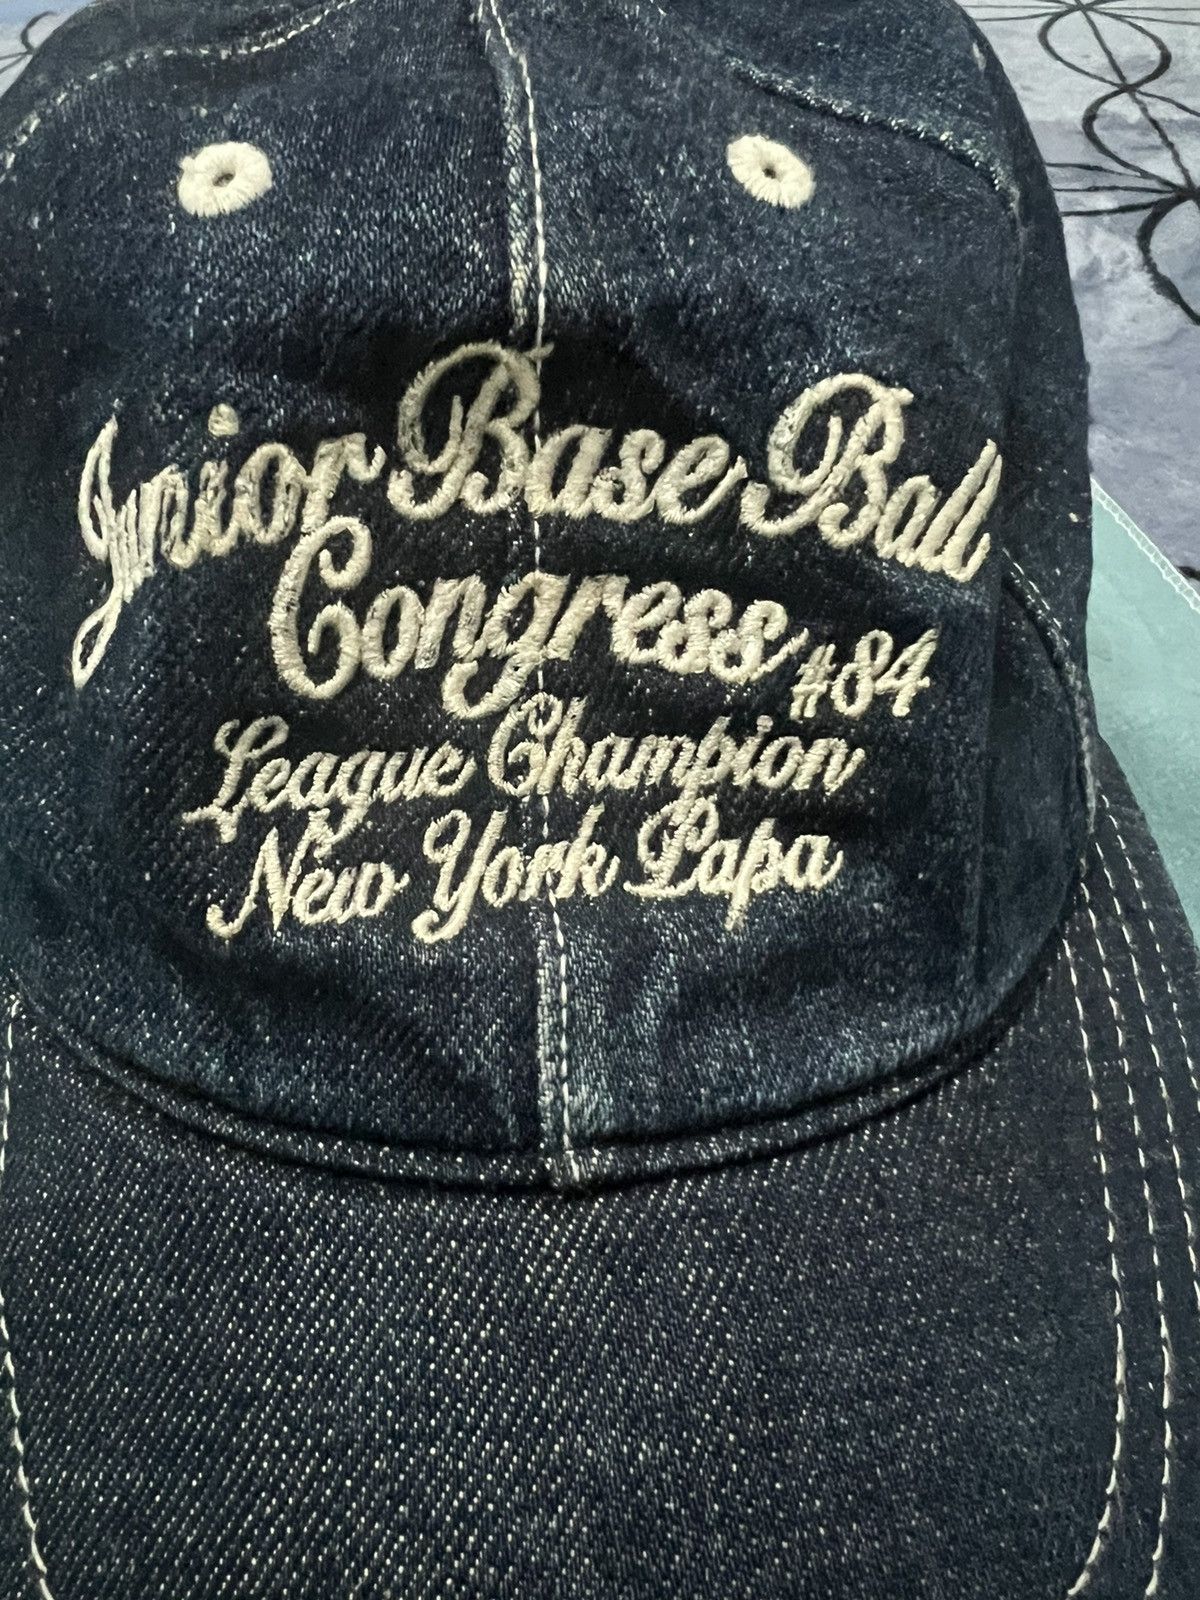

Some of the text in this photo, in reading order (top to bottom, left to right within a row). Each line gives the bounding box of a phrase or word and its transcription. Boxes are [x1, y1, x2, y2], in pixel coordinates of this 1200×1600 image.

[72, 339, 1002, 690] Junior Base Ball
[271, 515, 940, 722] Congress #84
[182, 692, 866, 857] League Champion
[205, 826, 410, 938] New
[411, 803, 620, 944] York
